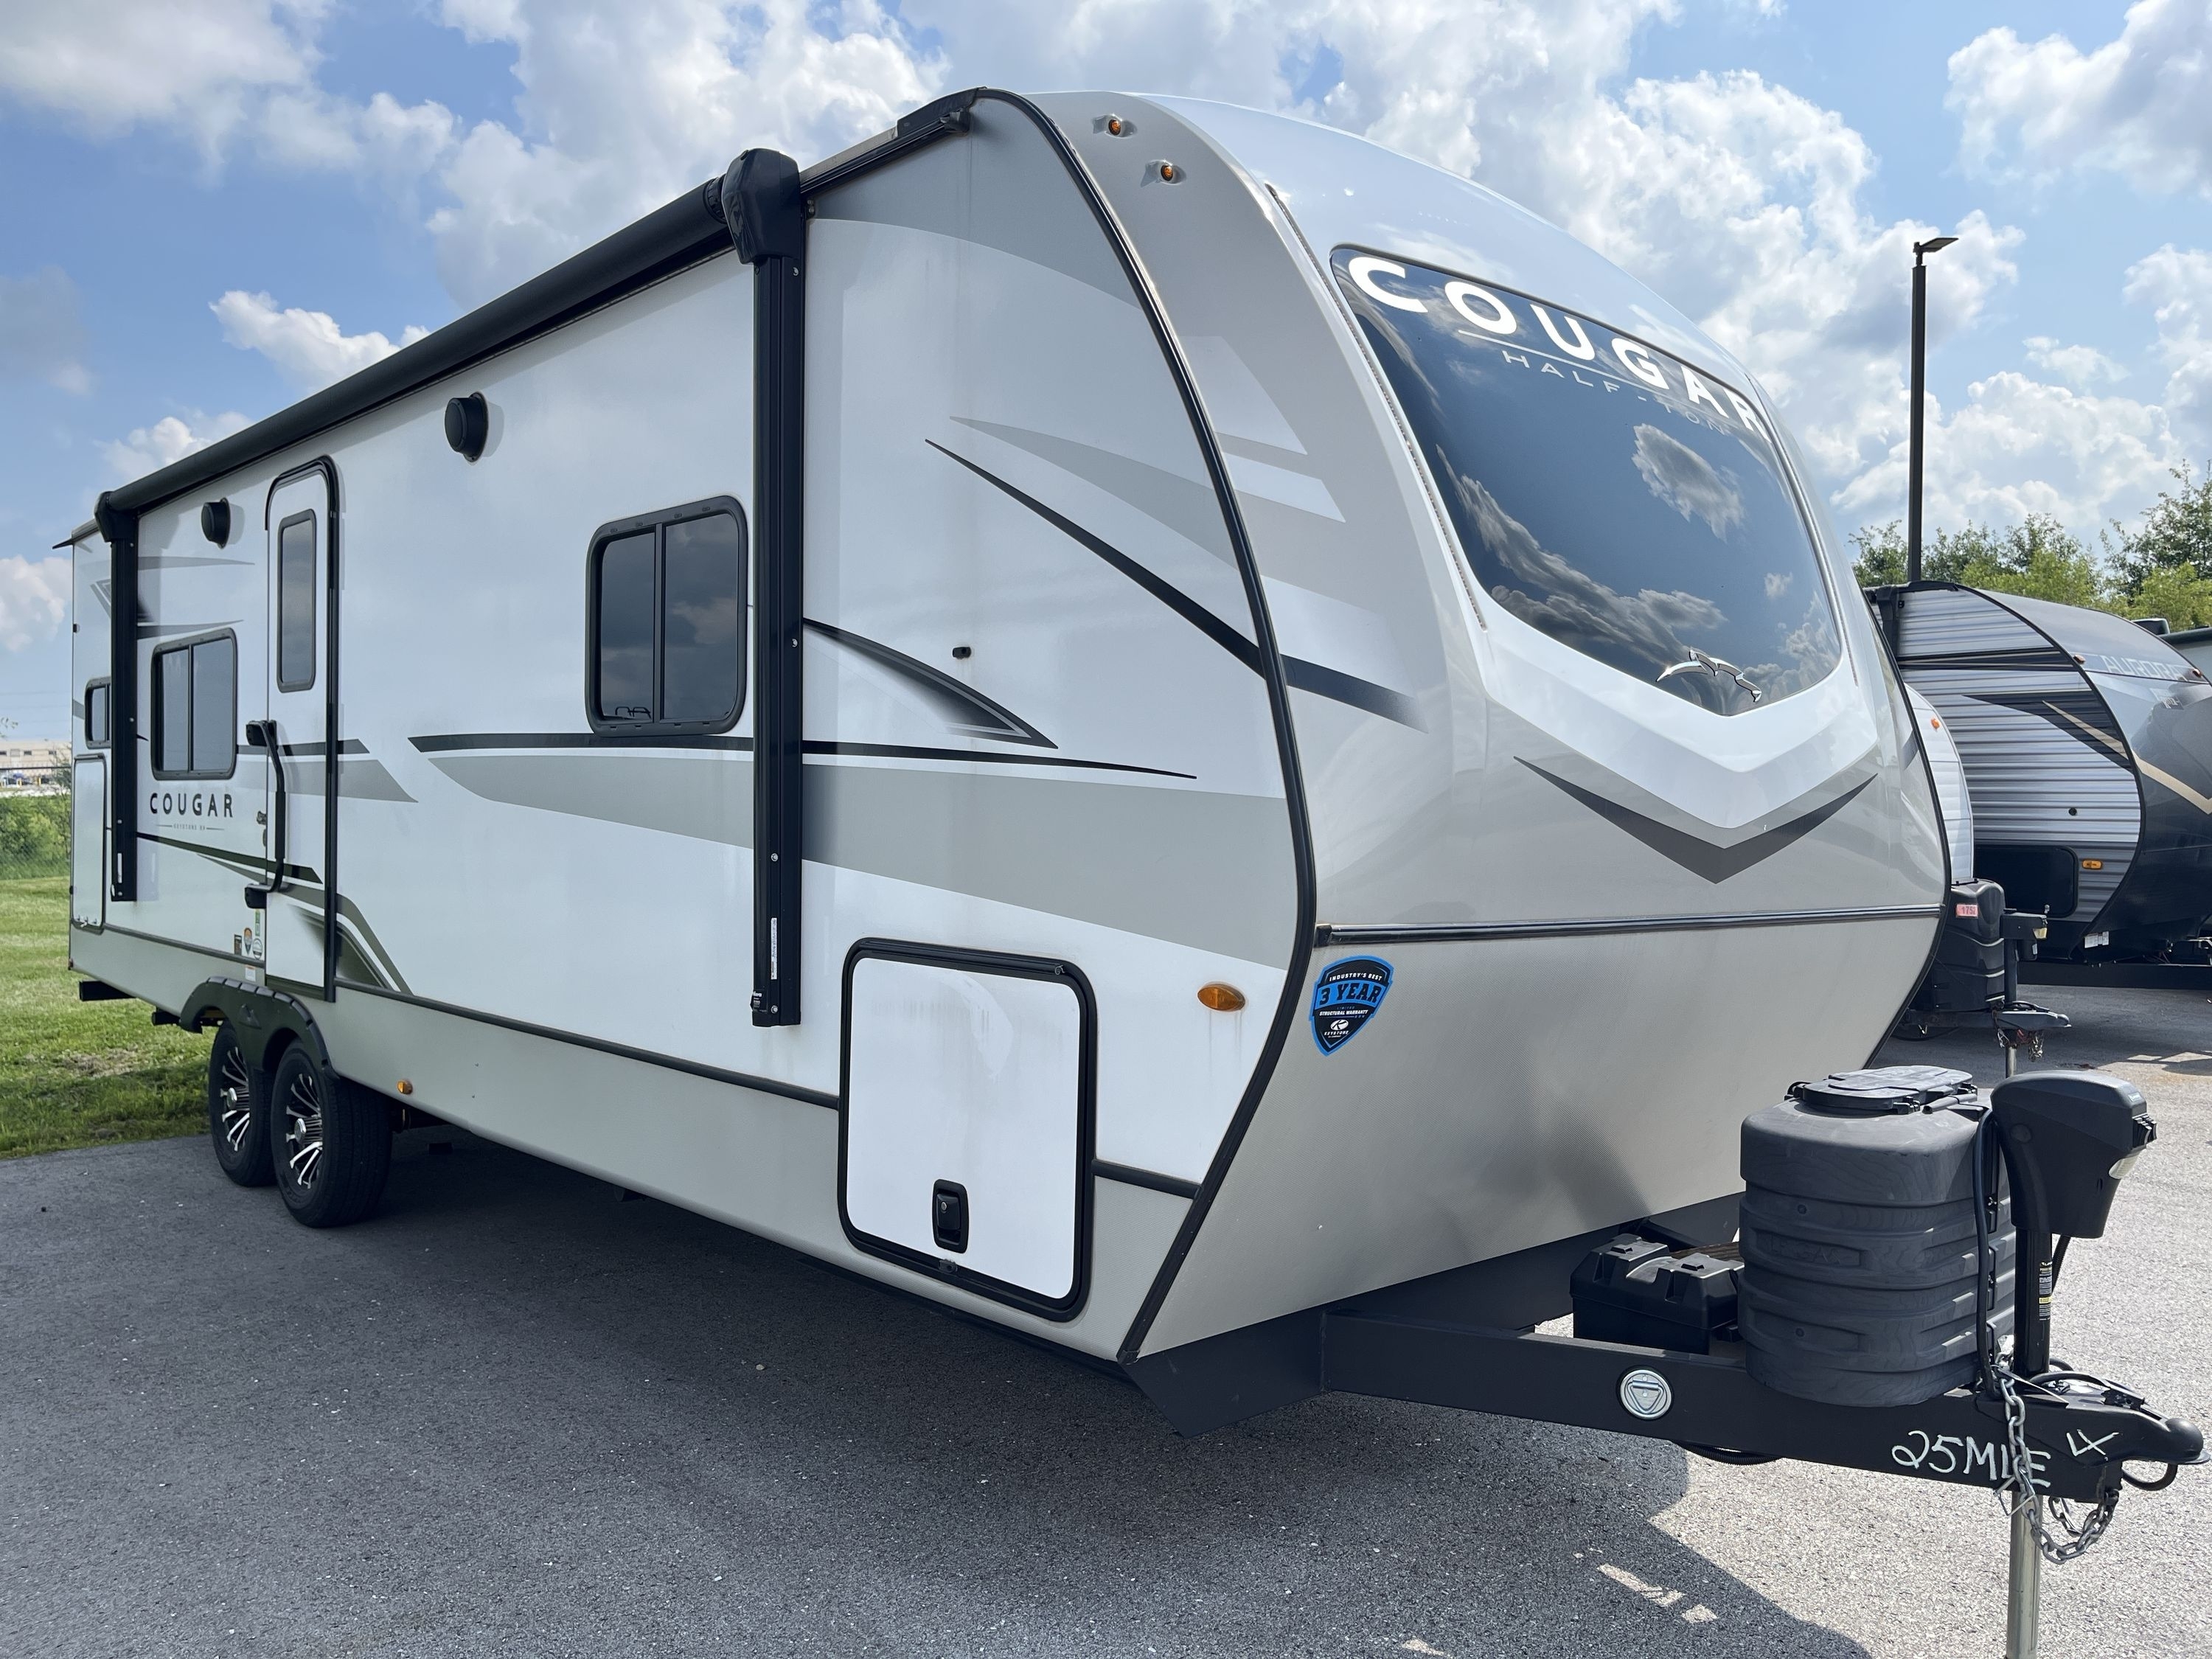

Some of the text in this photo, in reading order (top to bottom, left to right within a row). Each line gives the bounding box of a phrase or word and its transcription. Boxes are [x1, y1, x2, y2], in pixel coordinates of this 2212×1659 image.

[1348, 257, 1772, 442] COUGAR
[2101, 655, 2188, 682] AURORA
[150, 793, 233, 818] COUGAR
[1329, 973, 1382, 981] INDUSTRY'S BEST
[1319, 983, 1382, 1005] 3 YEAR
